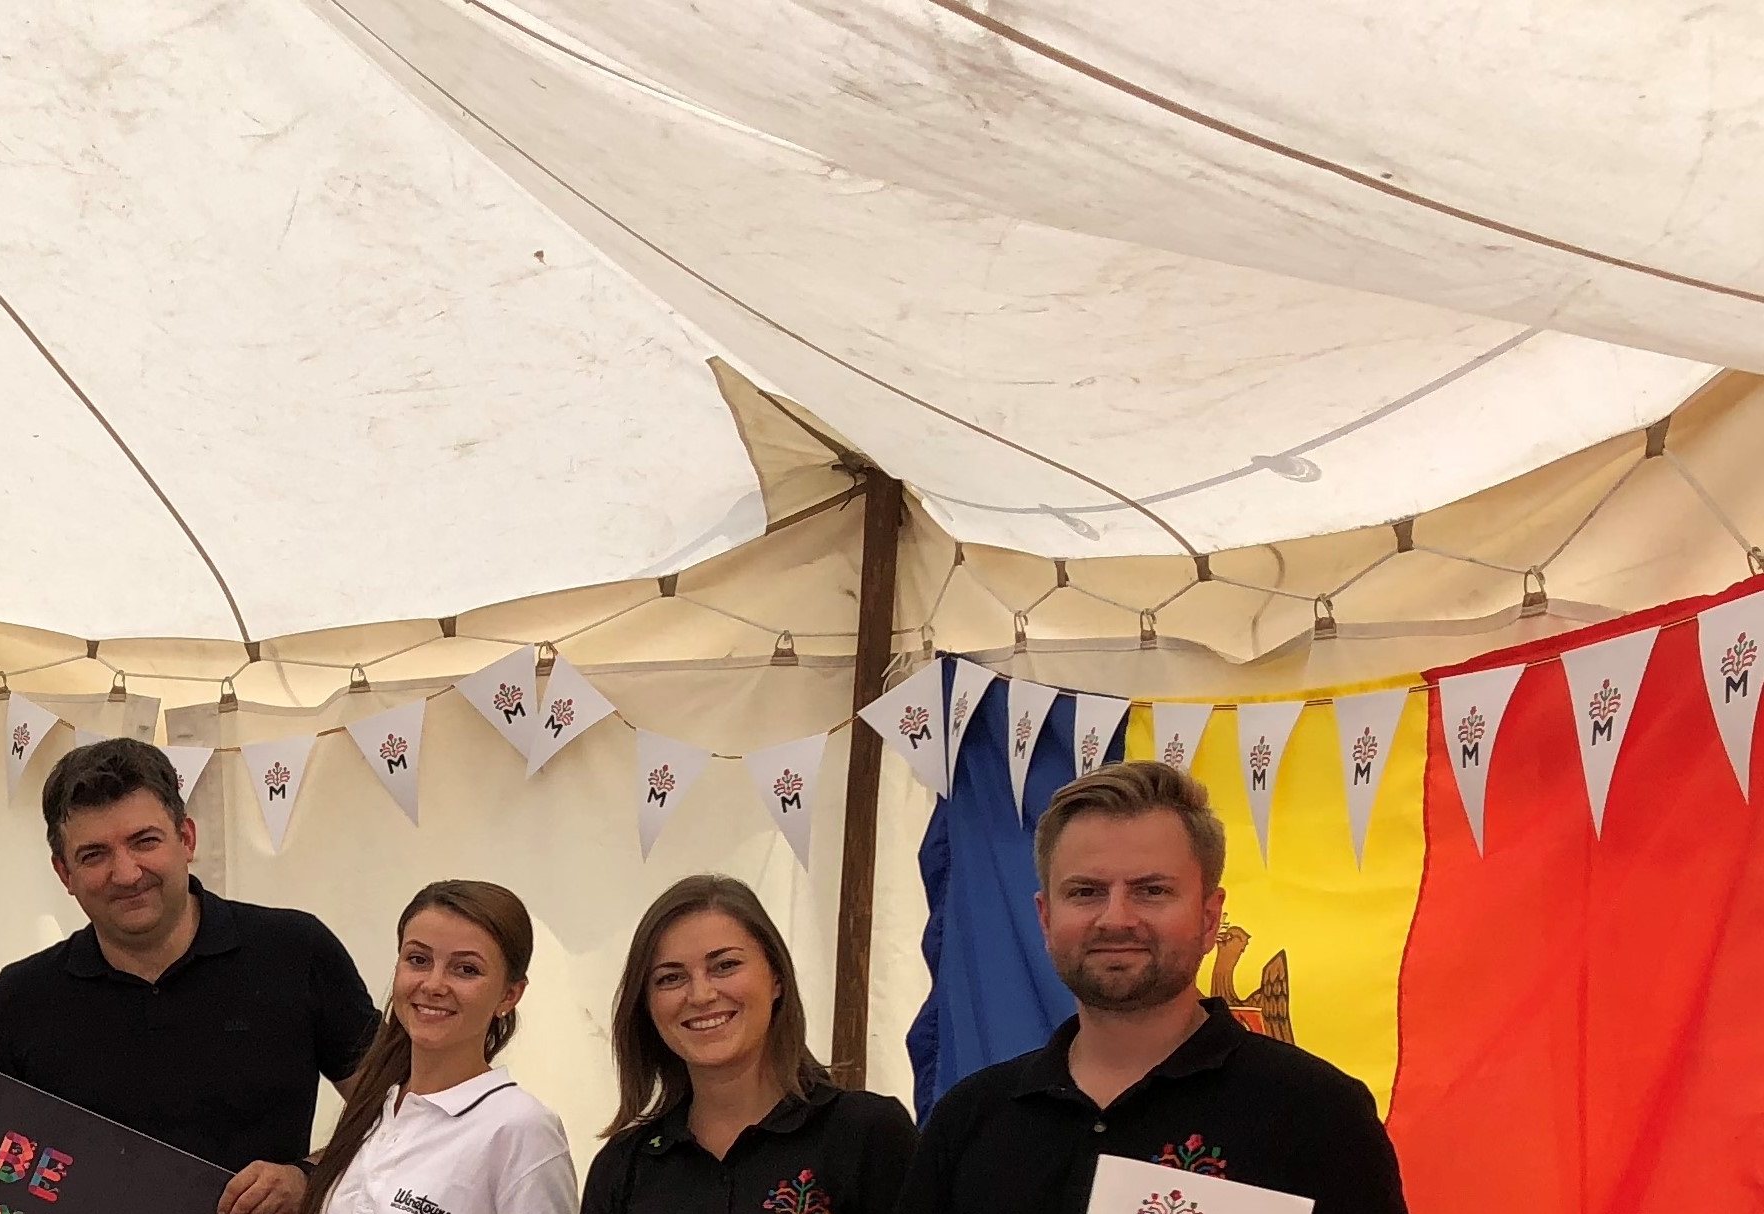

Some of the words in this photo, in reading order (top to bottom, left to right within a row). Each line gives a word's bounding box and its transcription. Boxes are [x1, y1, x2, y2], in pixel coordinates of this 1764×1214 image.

[1725, 670, 1749, 704] M
[504, 704, 526, 724] M
[545, 715, 563, 738] M
[909, 725, 932, 749] M
[1592, 716, 1614, 746] M
[12, 743, 24, 760] M
[1015, 740, 1028, 760] M
[1462, 743, 1479, 769] M
[387, 755, 408, 774] M
[1354, 762, 1372, 785] M
[1253, 769, 1266, 791] M
[269, 786, 286, 801] M
[648, 787, 667, 807] M
[781, 793, 802, 813] M
